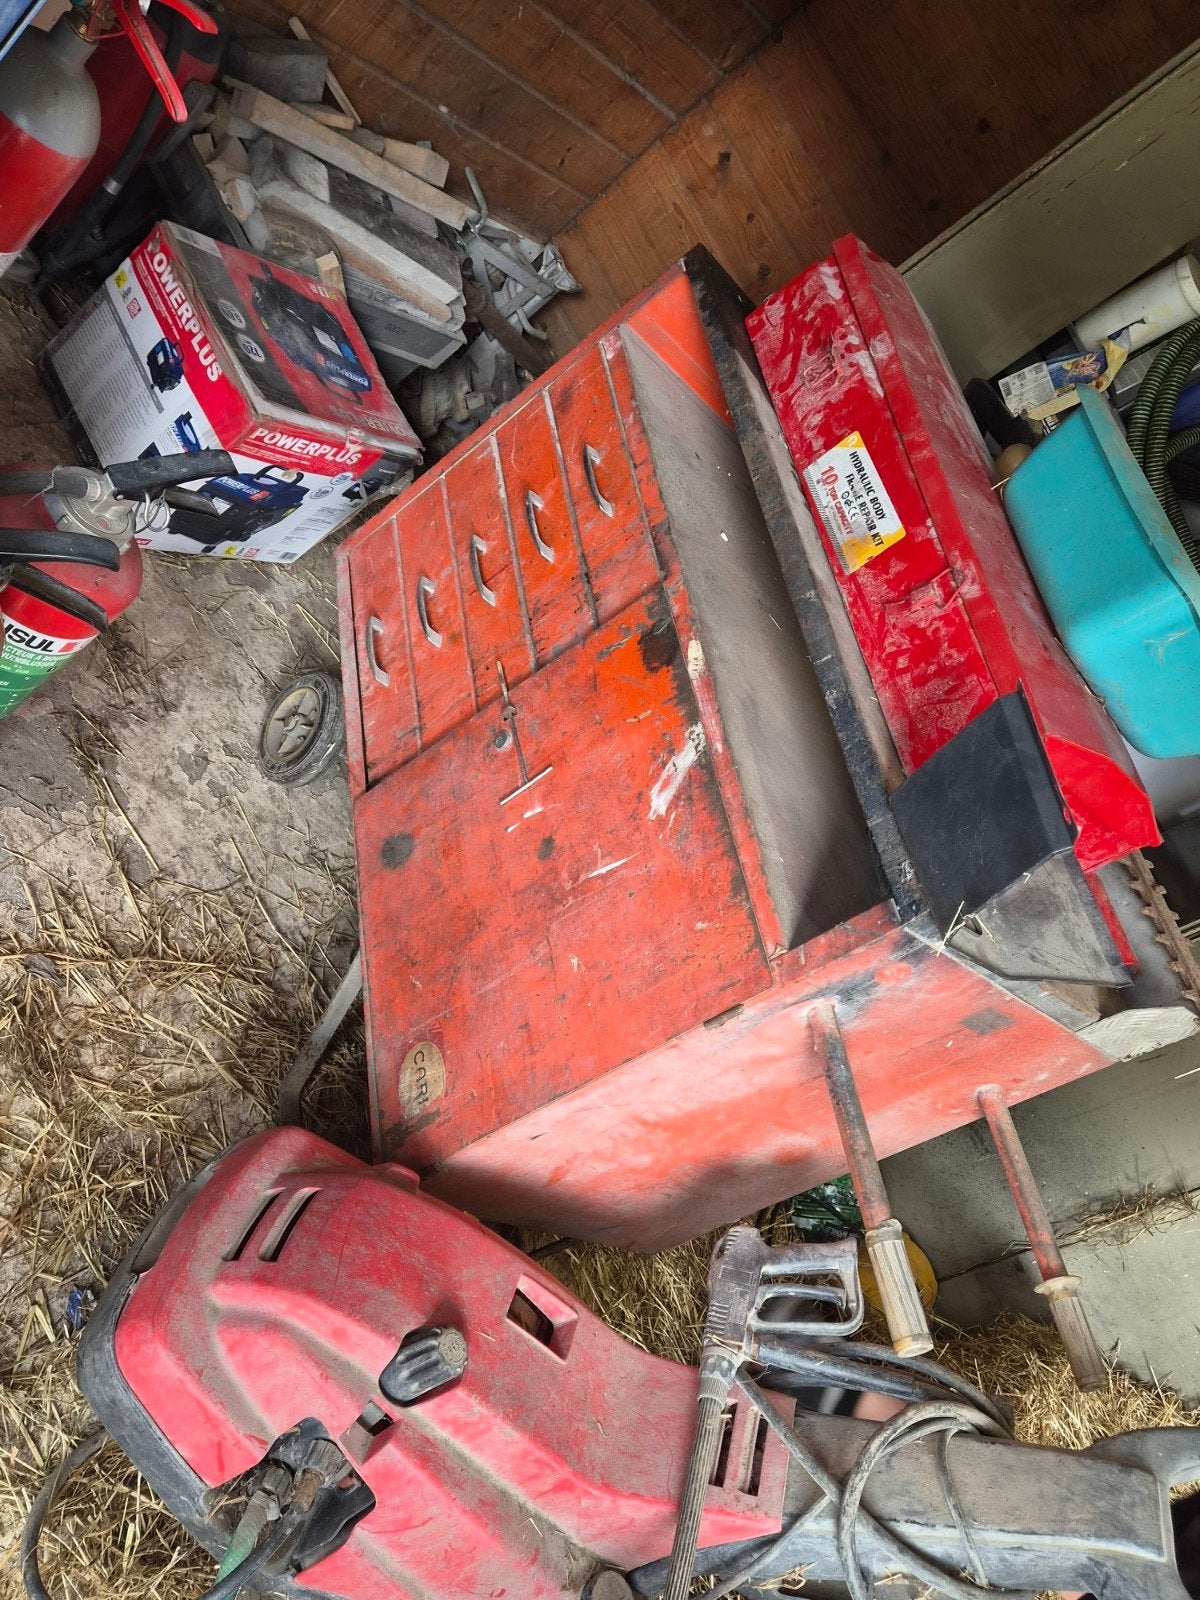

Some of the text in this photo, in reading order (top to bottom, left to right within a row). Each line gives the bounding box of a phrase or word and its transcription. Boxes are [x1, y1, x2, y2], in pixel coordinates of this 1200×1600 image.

[149, 238, 222, 382] OWERPLUS
[250, 428, 362, 464] POWERPLUS
[219, 475, 261, 495] POWERPLUS
[821, 465, 854, 535] 10 TON CAPACITY
[849, 451, 887, 520] HYDRAULIC BODY
[857, 501, 877, 532] REPAIR
[871, 532, 885, 547] KIT
